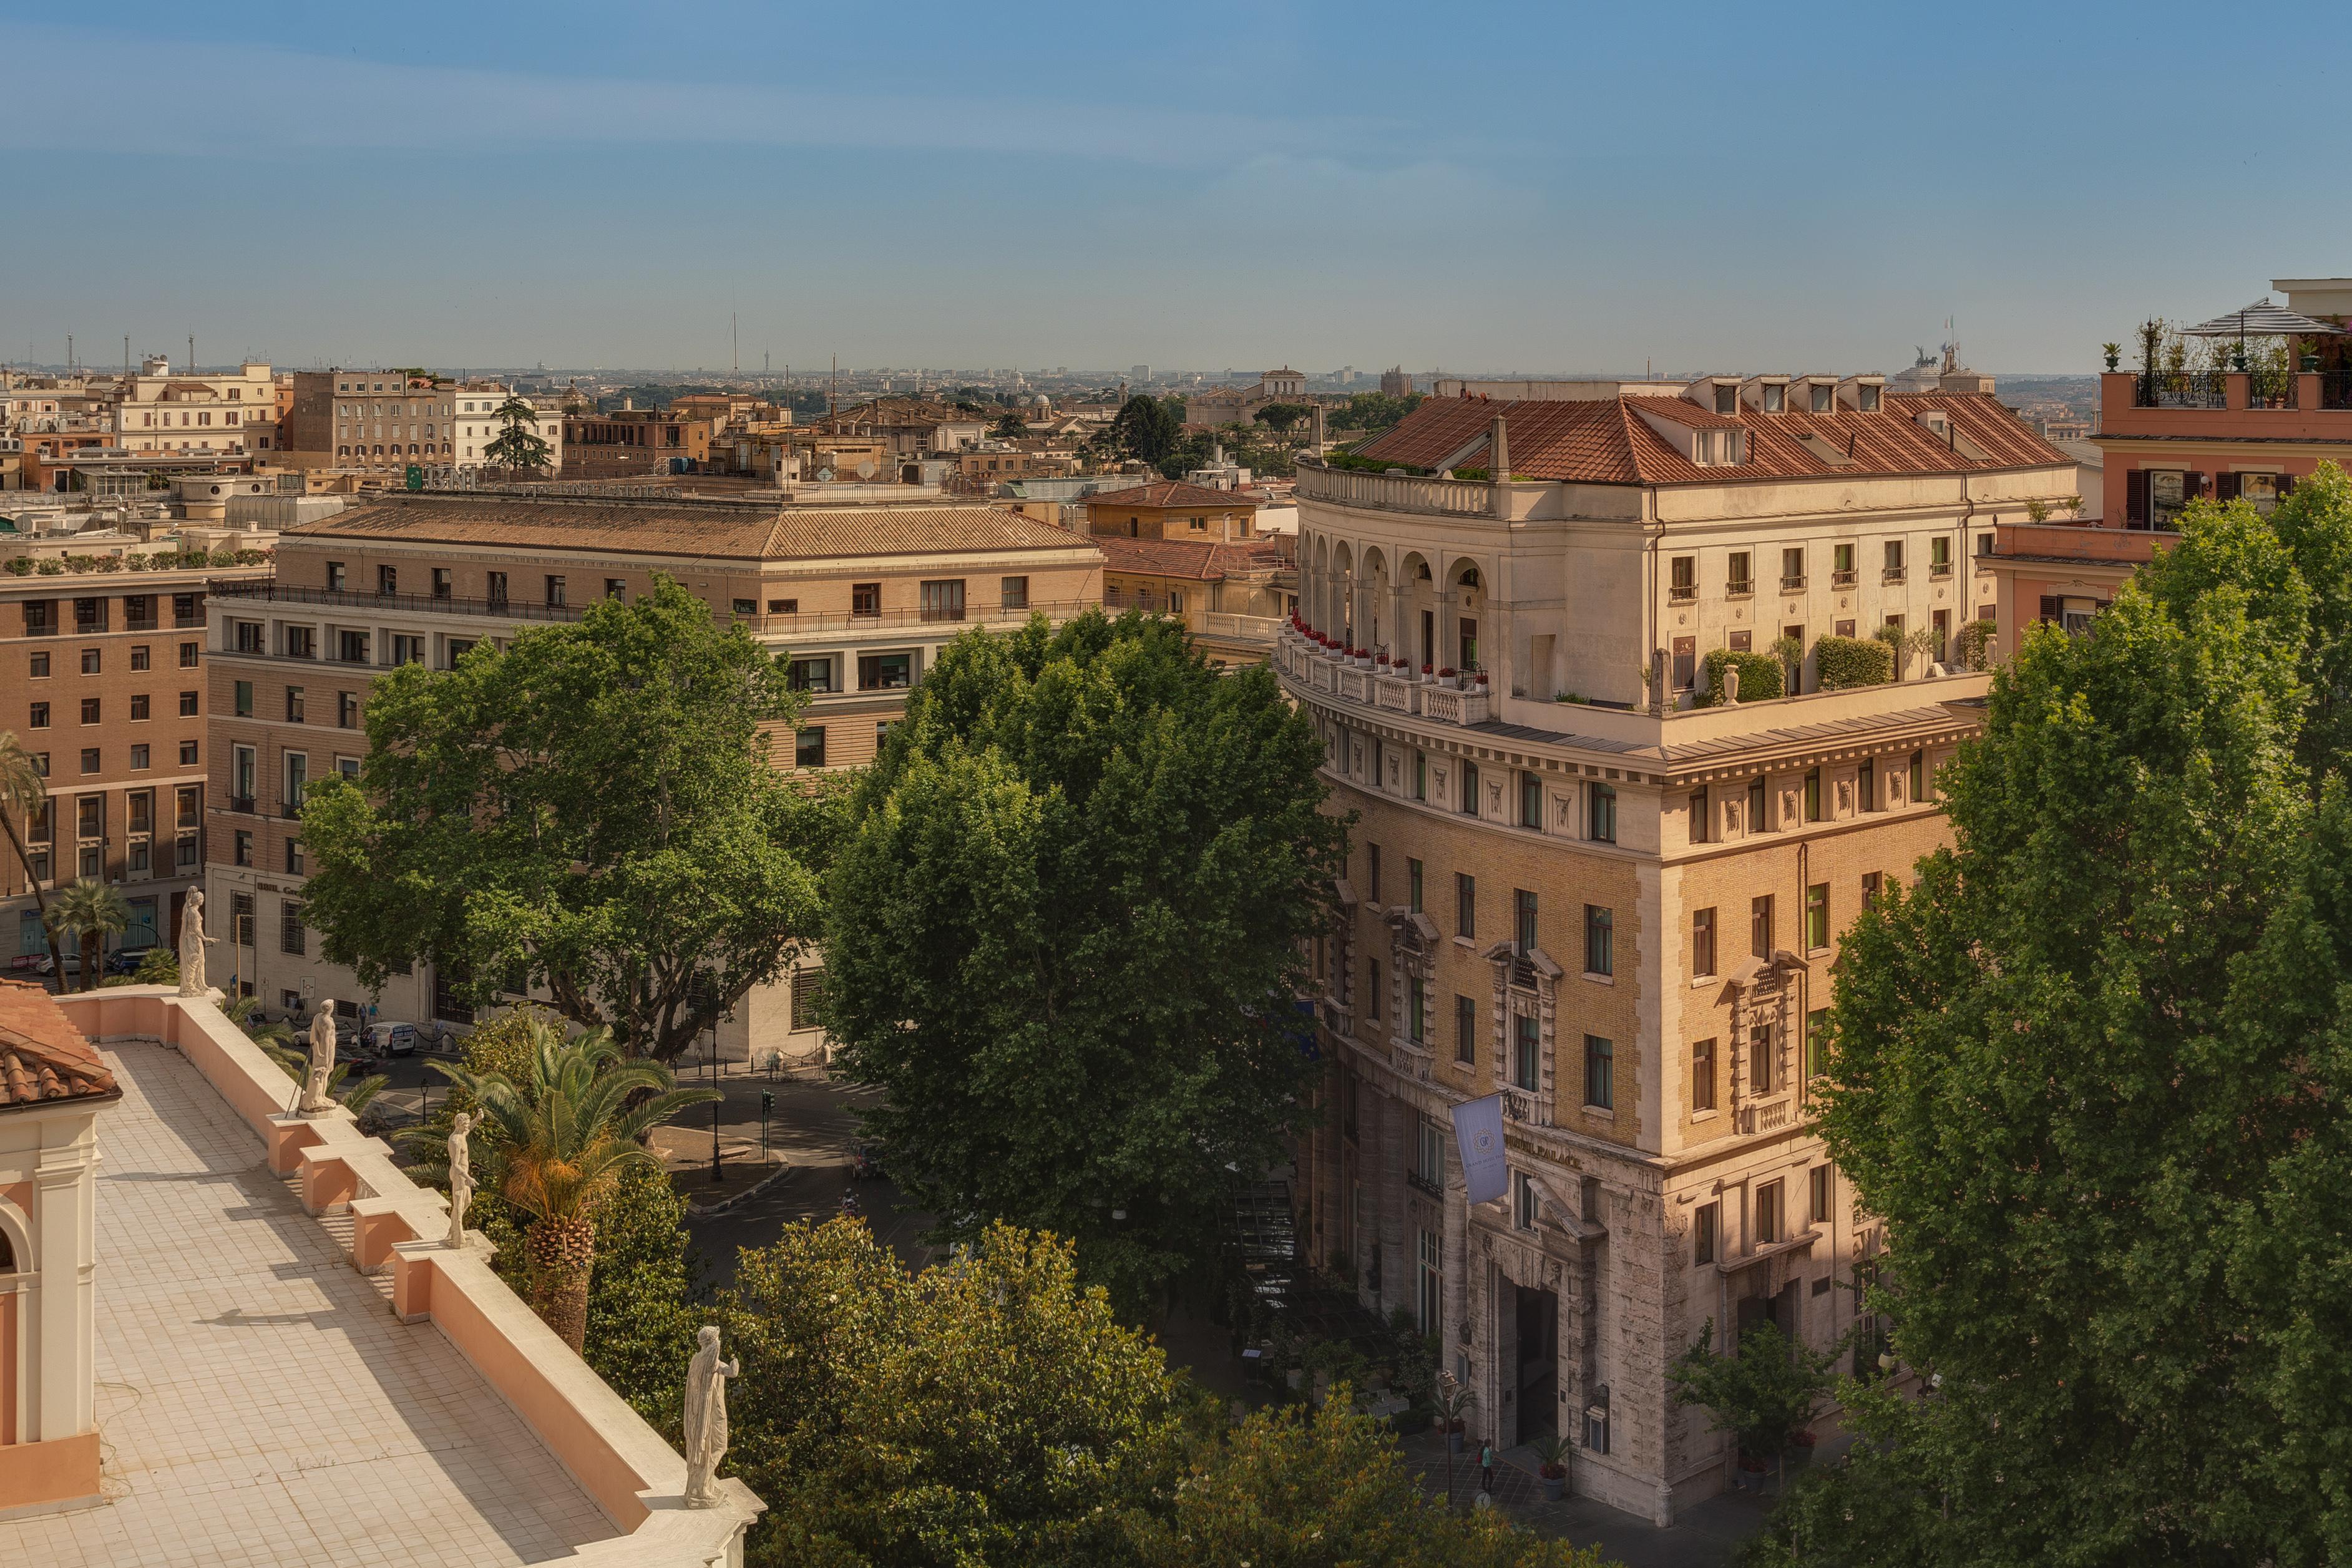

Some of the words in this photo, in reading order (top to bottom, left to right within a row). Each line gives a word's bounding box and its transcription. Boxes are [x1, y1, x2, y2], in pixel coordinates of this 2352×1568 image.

[427, 468, 486, 491] BNL
[493, 480, 554, 497] Gruppo
[601, 485, 683, 499] PARIBAS
[263, 884, 280, 893] BNL
[1536, 1146, 1583, 1170] PALACE
